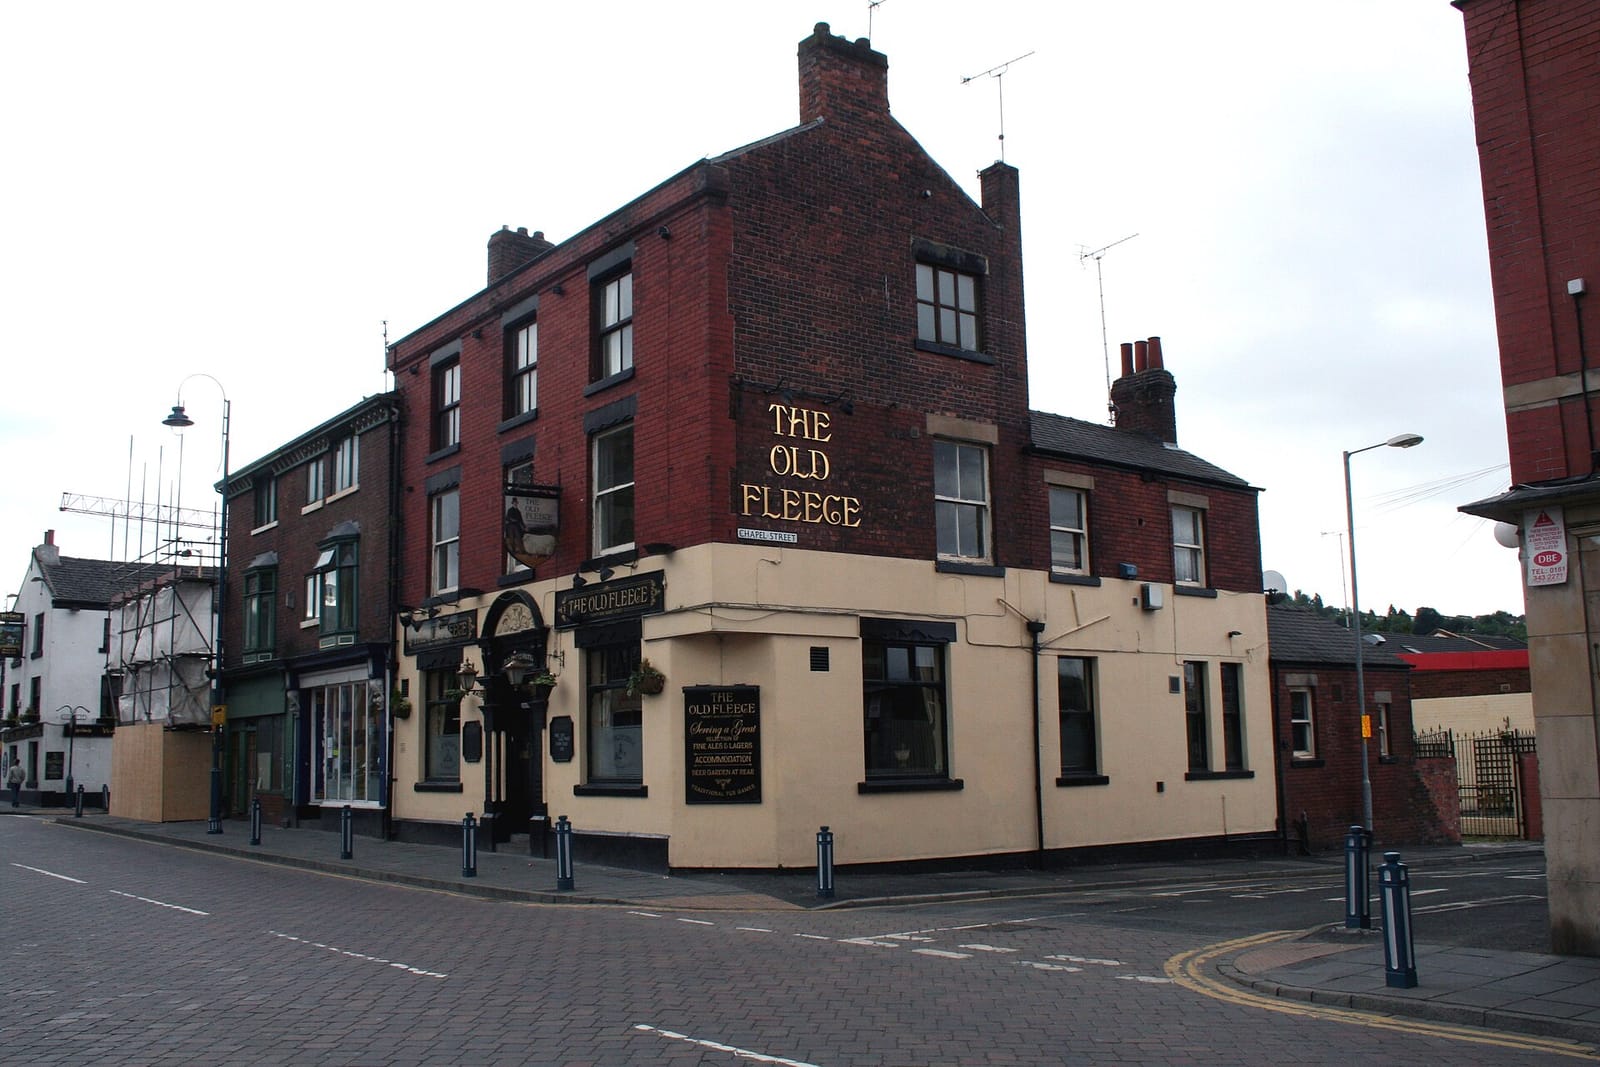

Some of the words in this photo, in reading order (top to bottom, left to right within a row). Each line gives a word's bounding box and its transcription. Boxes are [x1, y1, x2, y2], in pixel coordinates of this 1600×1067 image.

[769, 404, 832, 442] THE
[770, 445, 830, 480] OLD
[740, 483, 862, 527] FLEECE
[739, 530, 768, 539] CHAPEL
[769, 532, 796, 541] STREET
[1538, 554, 1558, 563] DBE
[568, 597, 587, 616] THE
[588, 593, 608, 612] OLD
[608, 586, 648, 608] FLEECE
[711, 692, 734, 703] THE
[688, 704, 711, 715] OLD
[712, 703, 756, 714] FLEECE
[707, 742, 723, 750] ALES
[695, 755, 752, 764] ACCOMMODATION
